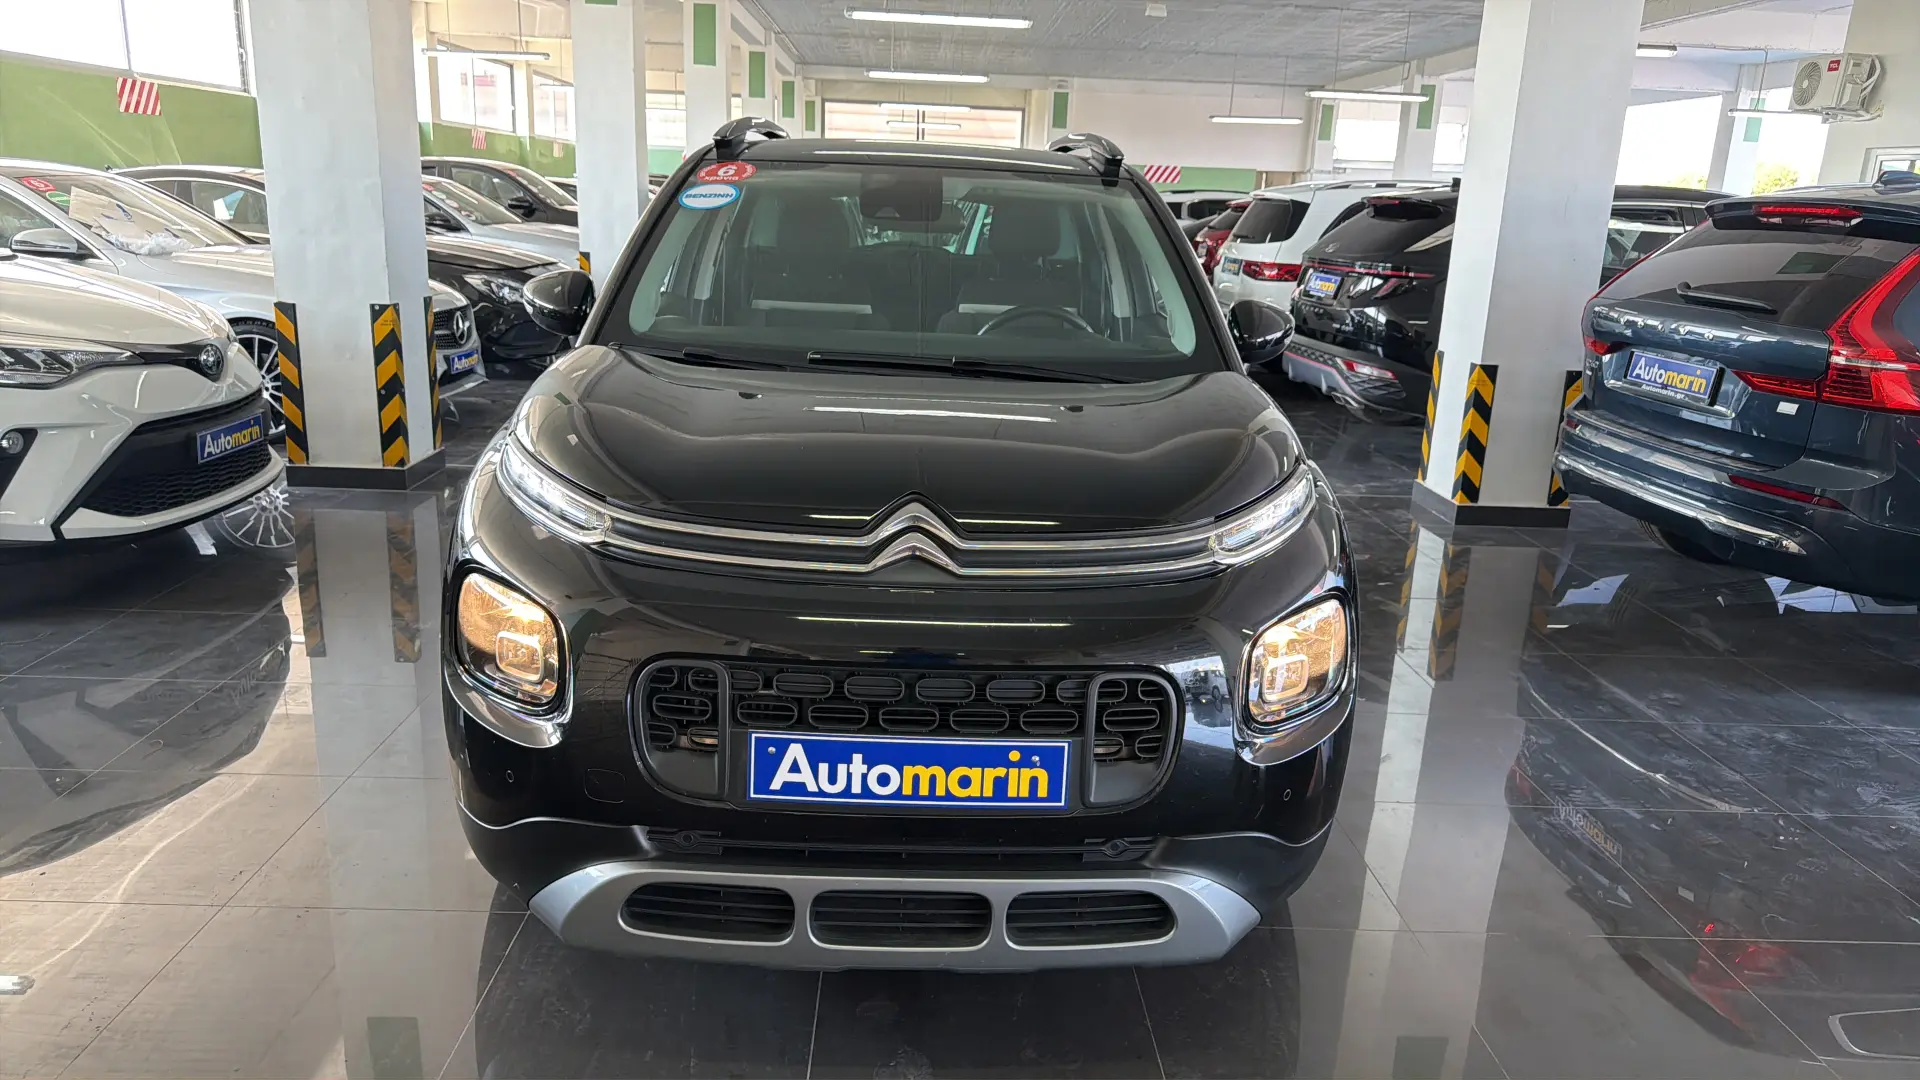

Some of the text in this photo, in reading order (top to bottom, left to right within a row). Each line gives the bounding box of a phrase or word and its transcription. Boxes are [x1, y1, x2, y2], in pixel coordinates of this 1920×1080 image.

[717, 164, 738, 177] 6
[1632, 357, 1707, 394] Automarin
[203, 419, 260, 458] Automarin
[768, 743, 1049, 798] Automarin
